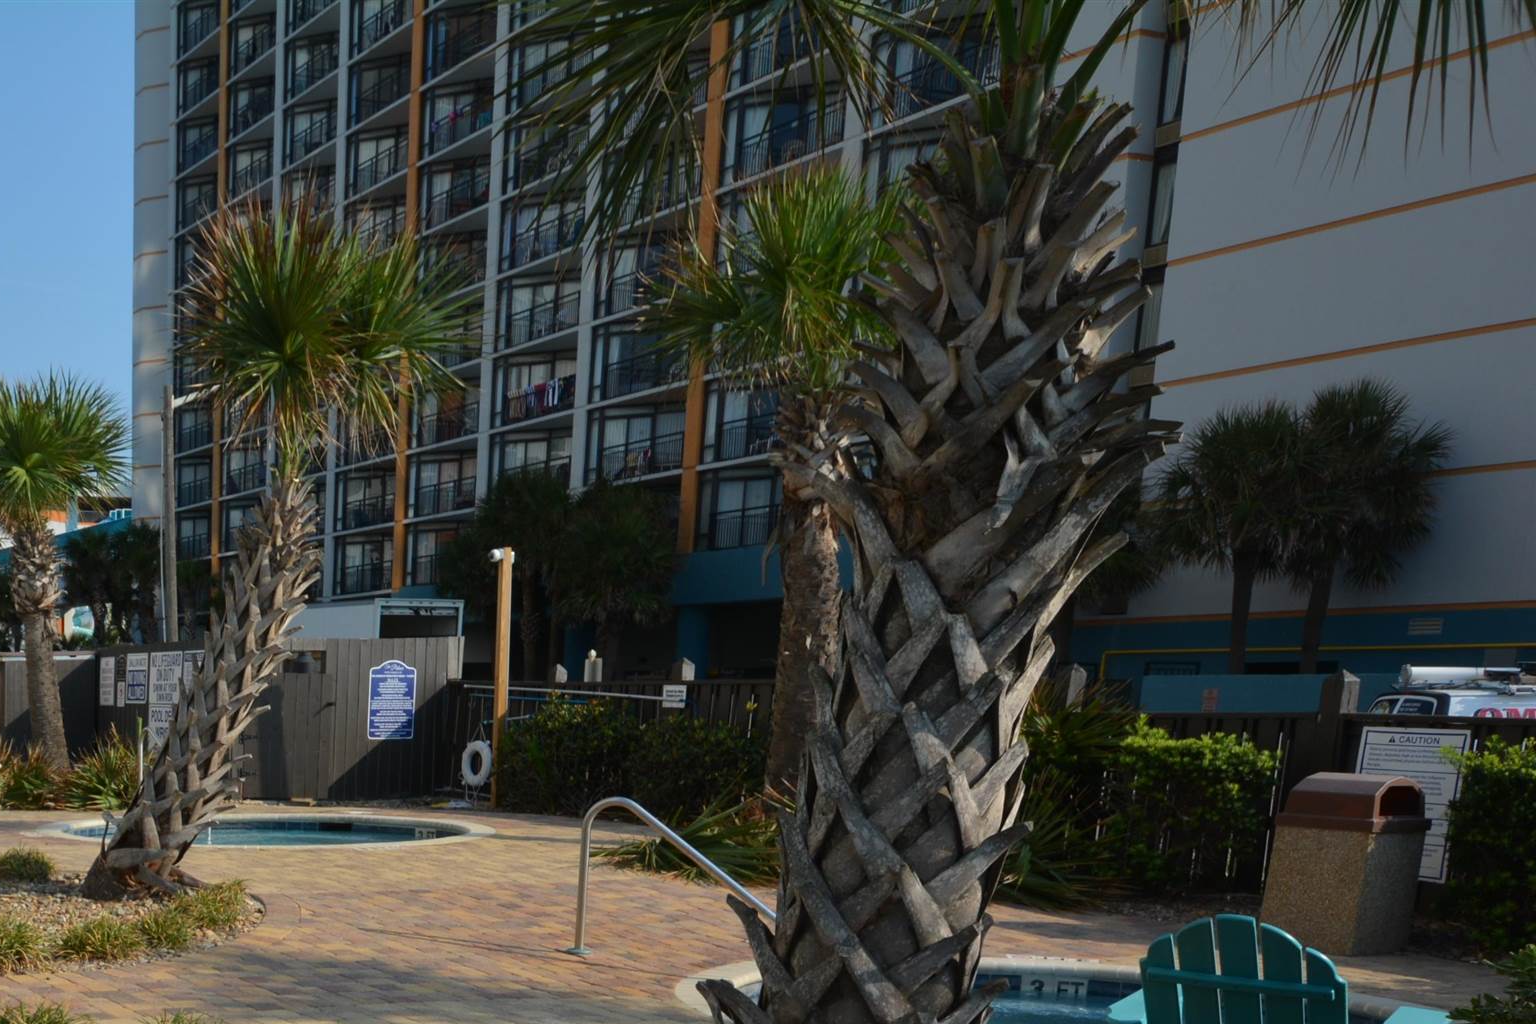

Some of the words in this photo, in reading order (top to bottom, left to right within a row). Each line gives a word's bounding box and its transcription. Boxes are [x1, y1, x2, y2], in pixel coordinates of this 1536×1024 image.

[1399, 735, 1441, 745] CAUTION
[1030, 979, 1045, 992] 3
[1057, 981, 1084, 994] FT
